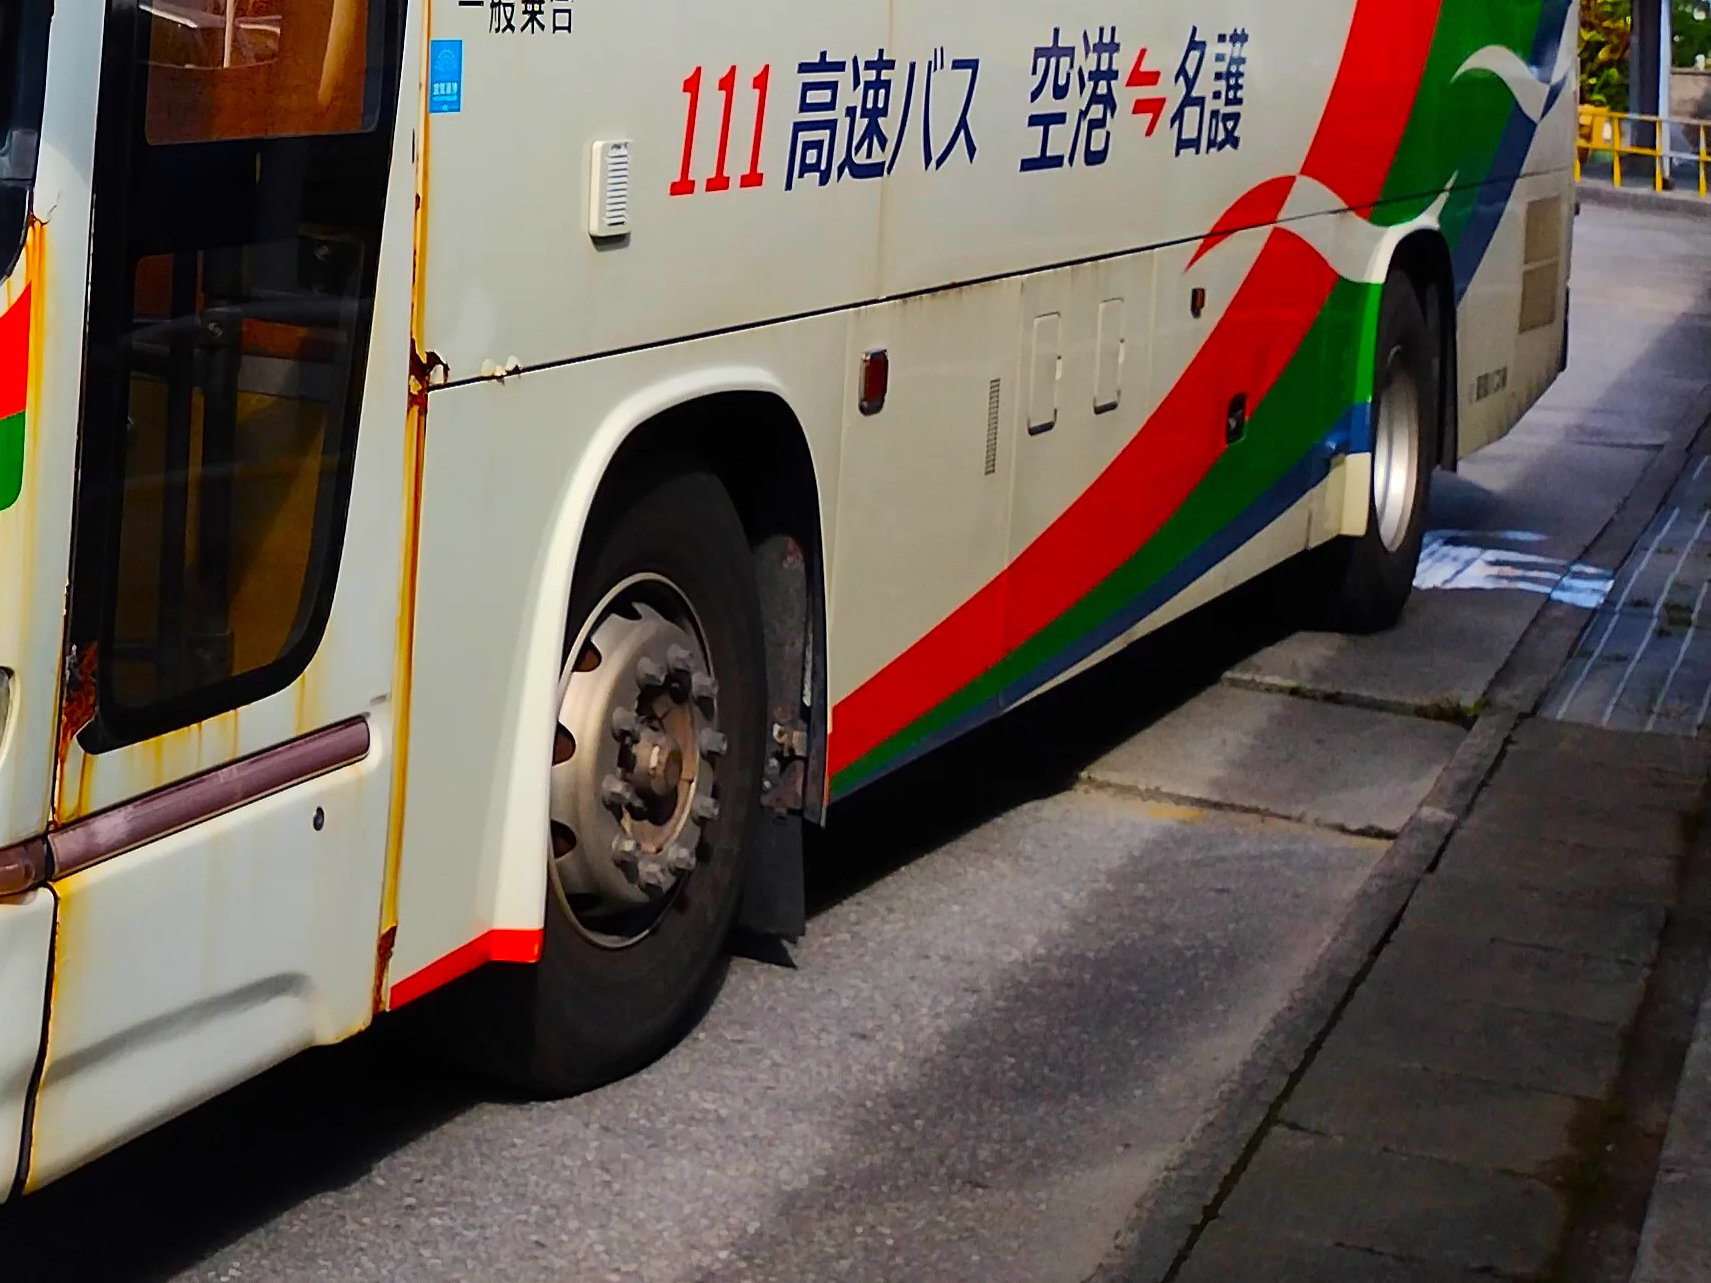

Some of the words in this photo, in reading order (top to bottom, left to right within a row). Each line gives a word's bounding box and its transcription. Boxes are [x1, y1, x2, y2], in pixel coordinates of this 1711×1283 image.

[669, 63, 771, 197] 111
[784, 45, 980, 192] 高速バス
[1019, 25, 1121, 173] 空港
[1169, 24, 1249, 157] 名護
